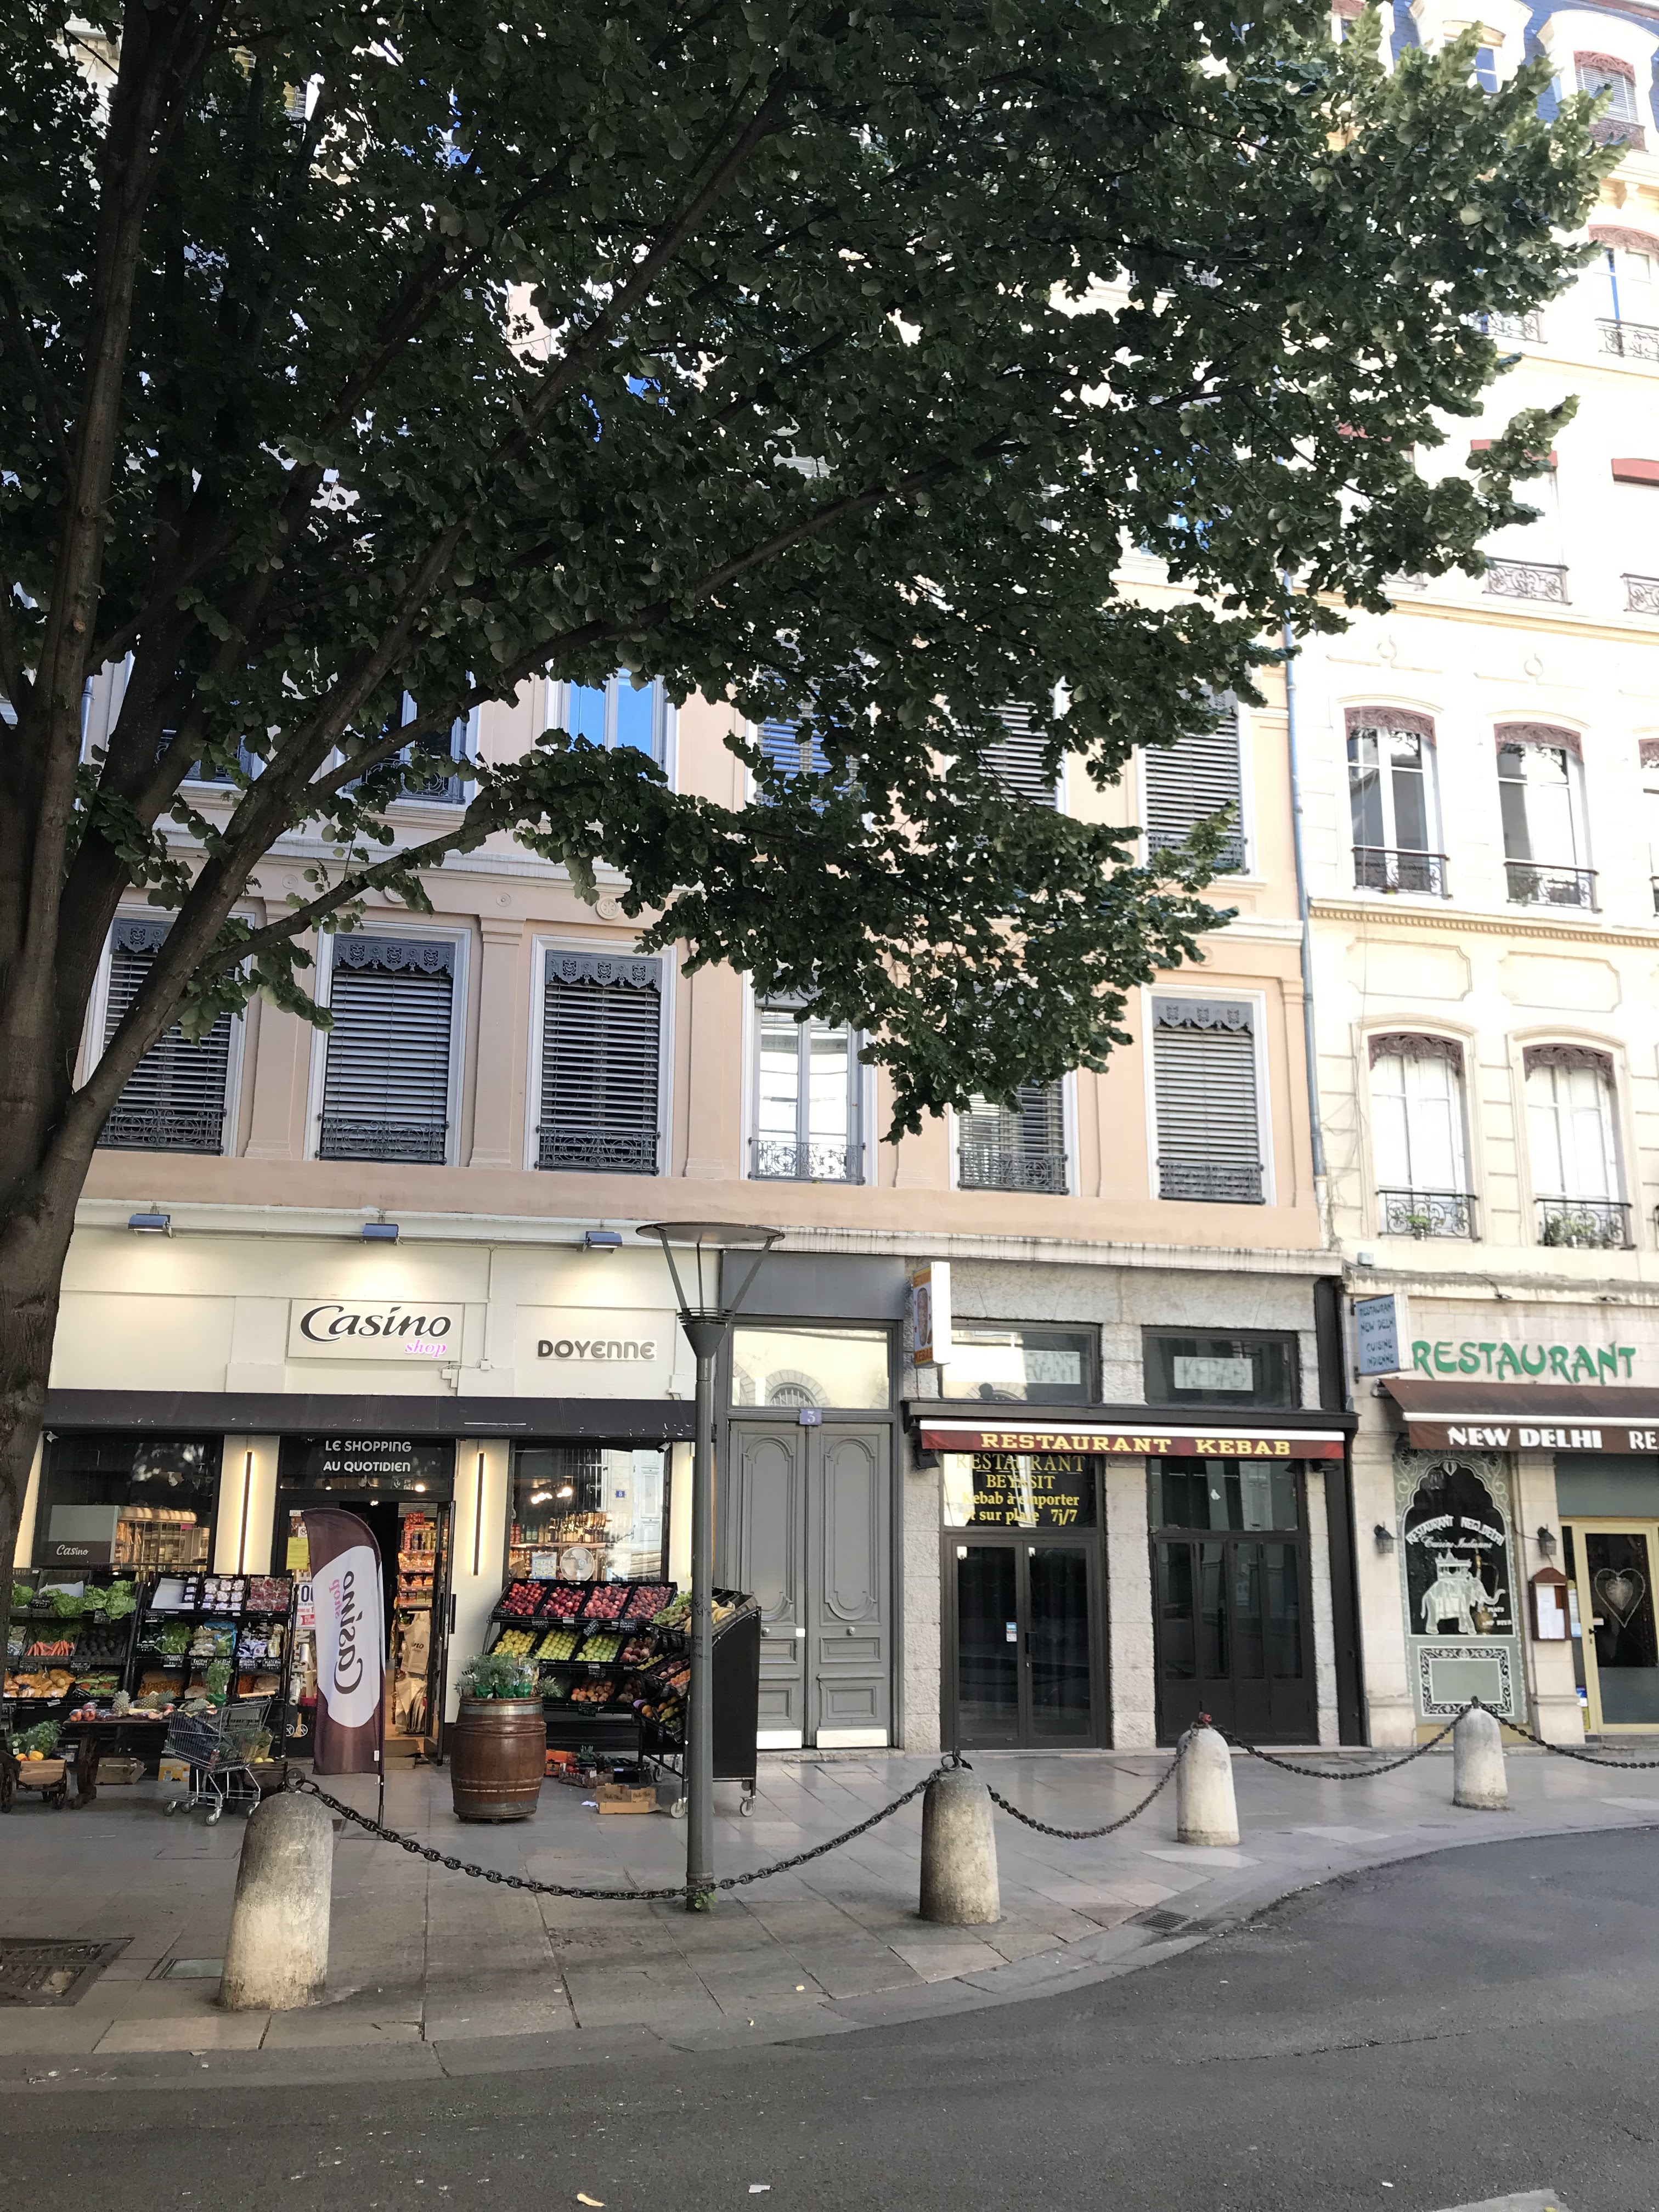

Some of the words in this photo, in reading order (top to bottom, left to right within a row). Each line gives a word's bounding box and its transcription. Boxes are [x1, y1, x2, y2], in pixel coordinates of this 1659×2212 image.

[300, 1305, 452, 1342] Casino
[404, 1340, 447, 1358] shop
[538, 1340, 655, 1359] DOYENNE
[1412, 1340, 1636, 1385] RESTAURANT
[807, 1410, 816, 1423] 3
[325, 1441, 341, 1451] LE
[344, 1441, 412, 1453] SHOPPING
[981, 1434, 1172, 1453] RESTAURANT
[1196, 1440, 1291, 1455] KEBAB
[1447, 1426, 1511, 1447] NEW
[1519, 1429, 1602, 1448] DELHI
[1628, 1430, 1659, 1450] RE
[323, 1461, 341, 1471] AU
[343, 1462, 410, 1472] QUOTIDIEN
[956, 1453, 1086, 1472] RESTAURANT
[962, 1491, 1003, 1505] Kebab
[1007, 1492, 1015, 1504] à
[1020, 1494, 1080, 1509] emporter
[979, 1511, 1001, 1521] sur
[1051, 1509, 1077, 1526] 7j/7
[56, 1544, 89, 1555] Casino
